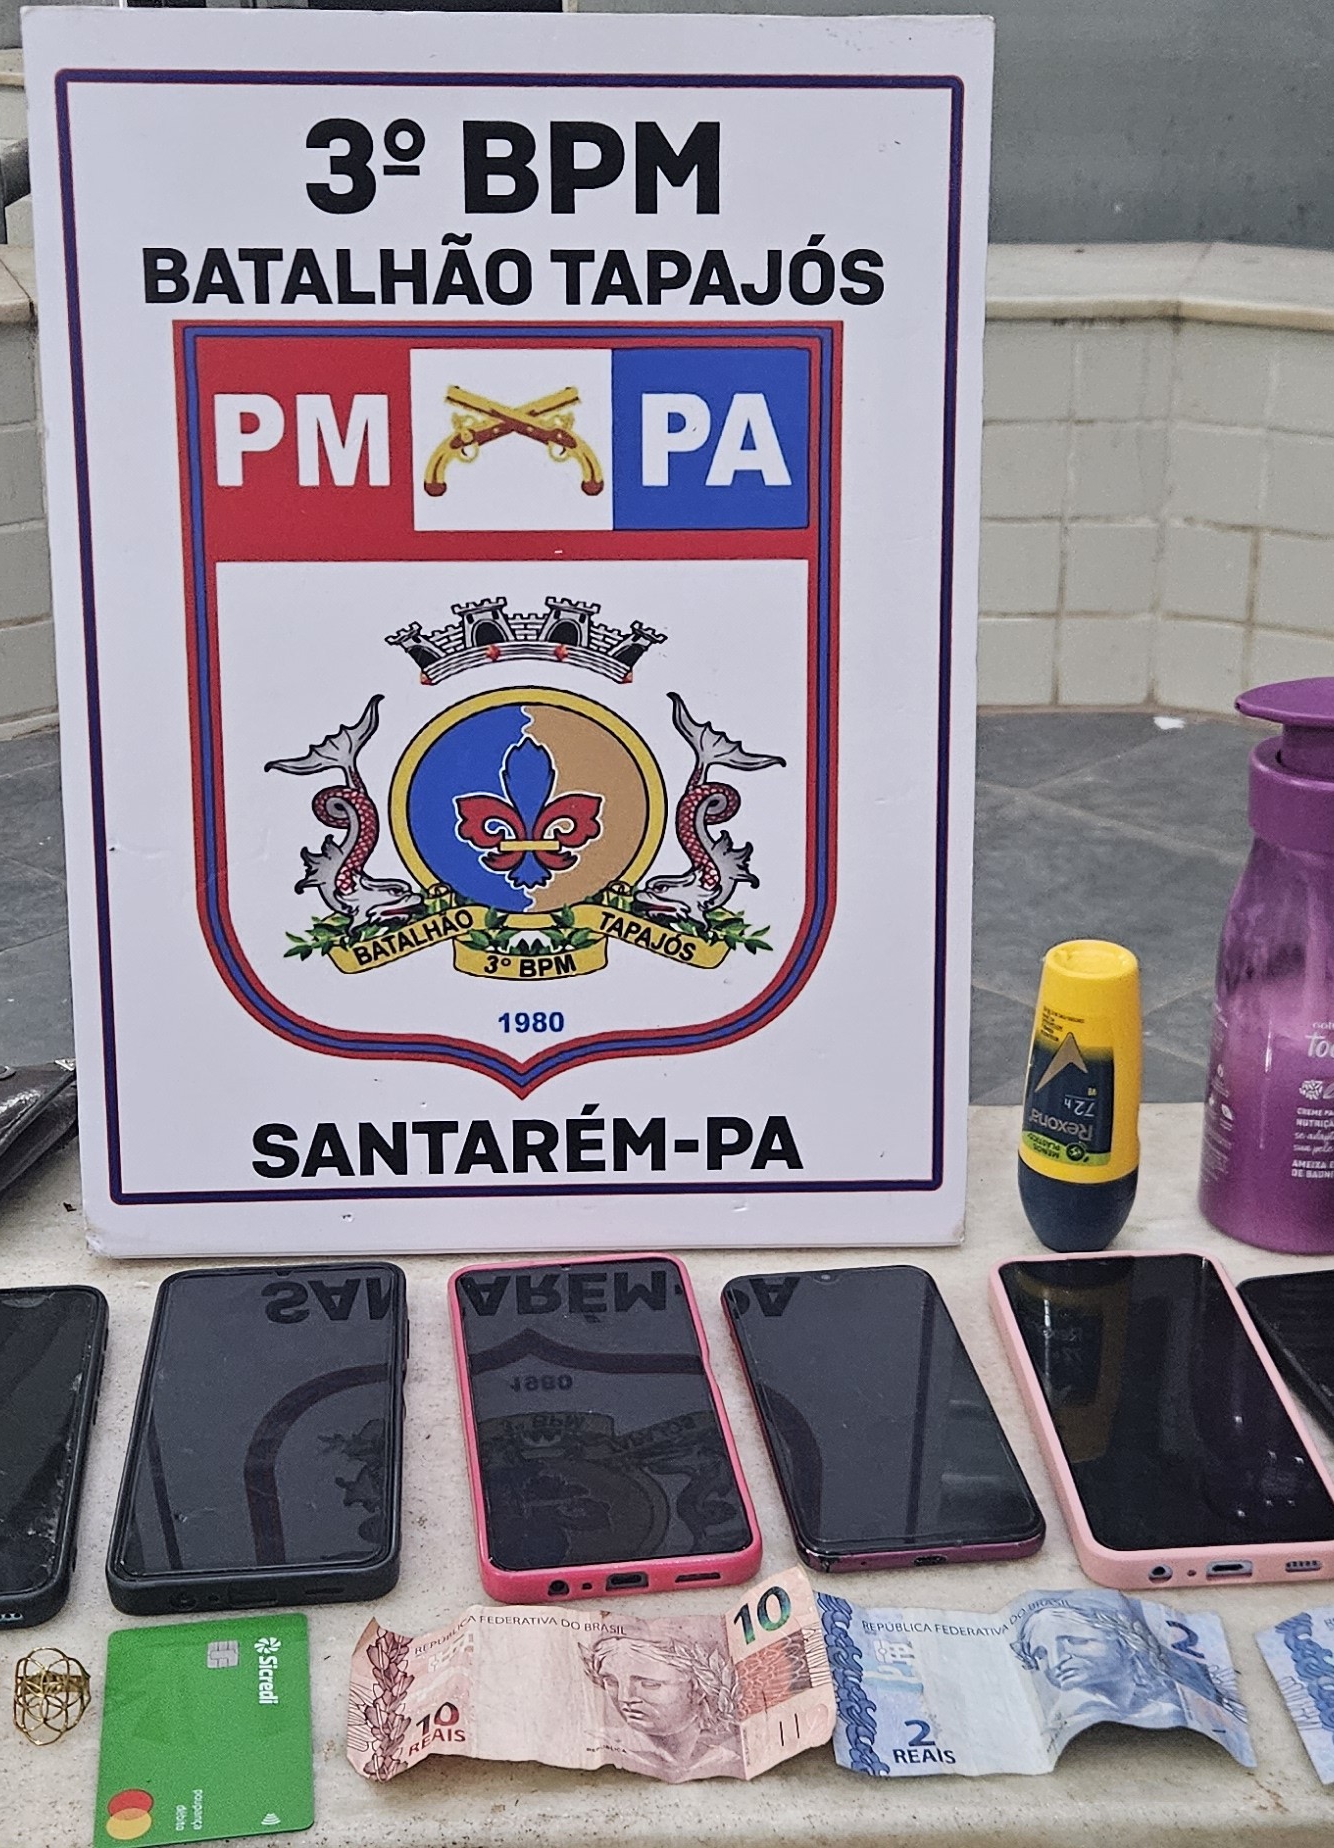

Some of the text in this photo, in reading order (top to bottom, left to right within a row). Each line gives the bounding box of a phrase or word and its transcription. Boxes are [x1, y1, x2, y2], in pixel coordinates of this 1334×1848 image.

[306, 118, 722, 215] 3º BPM
[143, 233, 884, 306] BATALHÃO TAPAJÓS
[214, 392, 792, 488] PM PA
[353, 908, 474, 966] BATALHÃO
[599, 911, 697, 964] TAPAJÓS
[519, 955, 577, 977] BPM
[498, 1012, 565, 1033] 1980
[1029, 1108, 1093, 1141] Rexona
[1074, 1100, 1095, 1117] 72
[252, 1105, 804, 1178] SANTARÉM-PA
[1291, 1168, 1303, 1178] DE
[1292, 1159, 1327, 1169] AMEIXA
[733, 1585, 792, 1645] 10
[862, 1620, 932, 1634] REPÚBLICA
[934, 1623, 1009, 1637] FEDERATIVA
[414, 1615, 628, 1655] REPÚBLICA FEDERATIVA DO BRASIL
[1166, 1620, 1205, 1659] 2
[258, 1655, 279, 1704] Sicredi
[416, 1701, 460, 1738] 10
[904, 1719, 936, 1747] 2
[408, 1728, 466, 1756] REAIS
[893, 1748, 957, 1764] REAIS
[175, 1805, 188, 1831] débito
[191, 1789, 203, 1830] poupança
